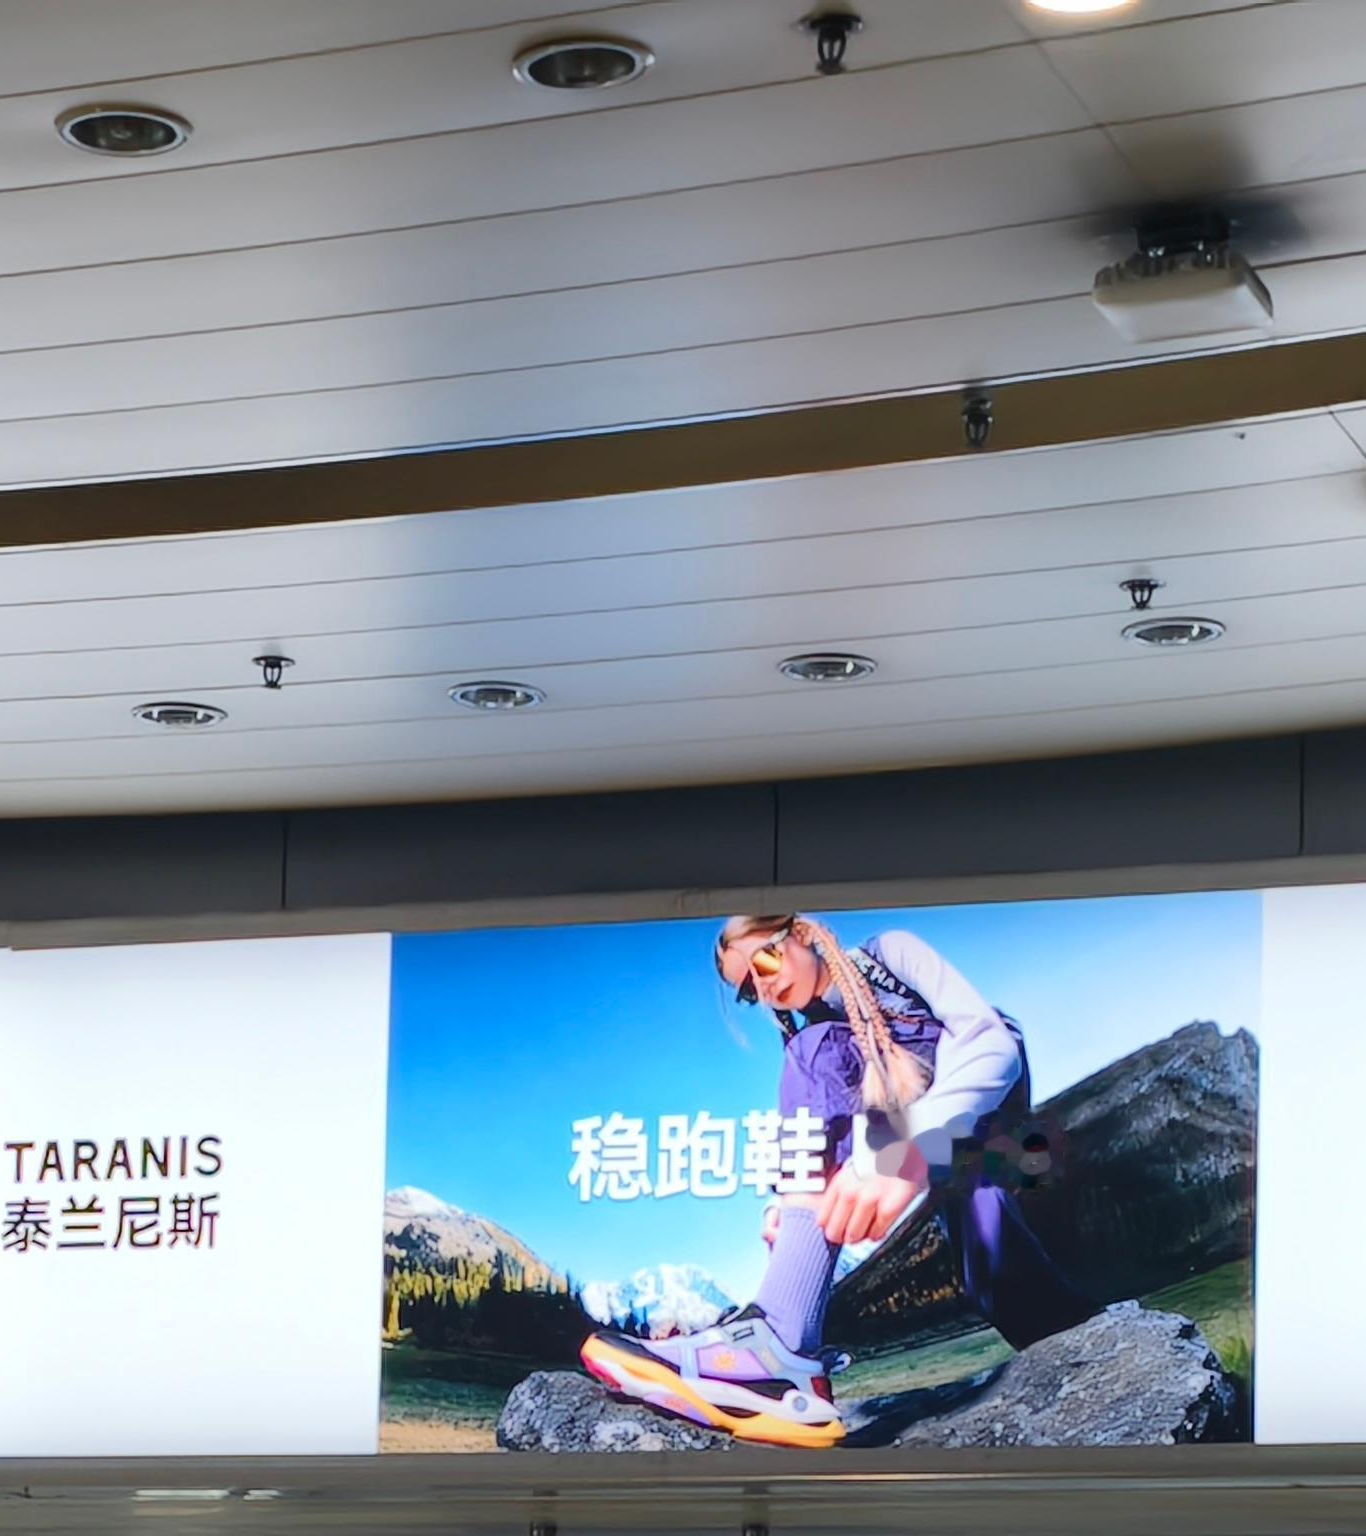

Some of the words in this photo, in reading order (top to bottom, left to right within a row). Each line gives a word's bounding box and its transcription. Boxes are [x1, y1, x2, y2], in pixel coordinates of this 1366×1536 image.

[4, 1135, 225, 1183] TARANIS
[567, 1107, 829, 1204] 稳跑鞋
[1, 1194, 220, 1253] 泰兰尼斯
